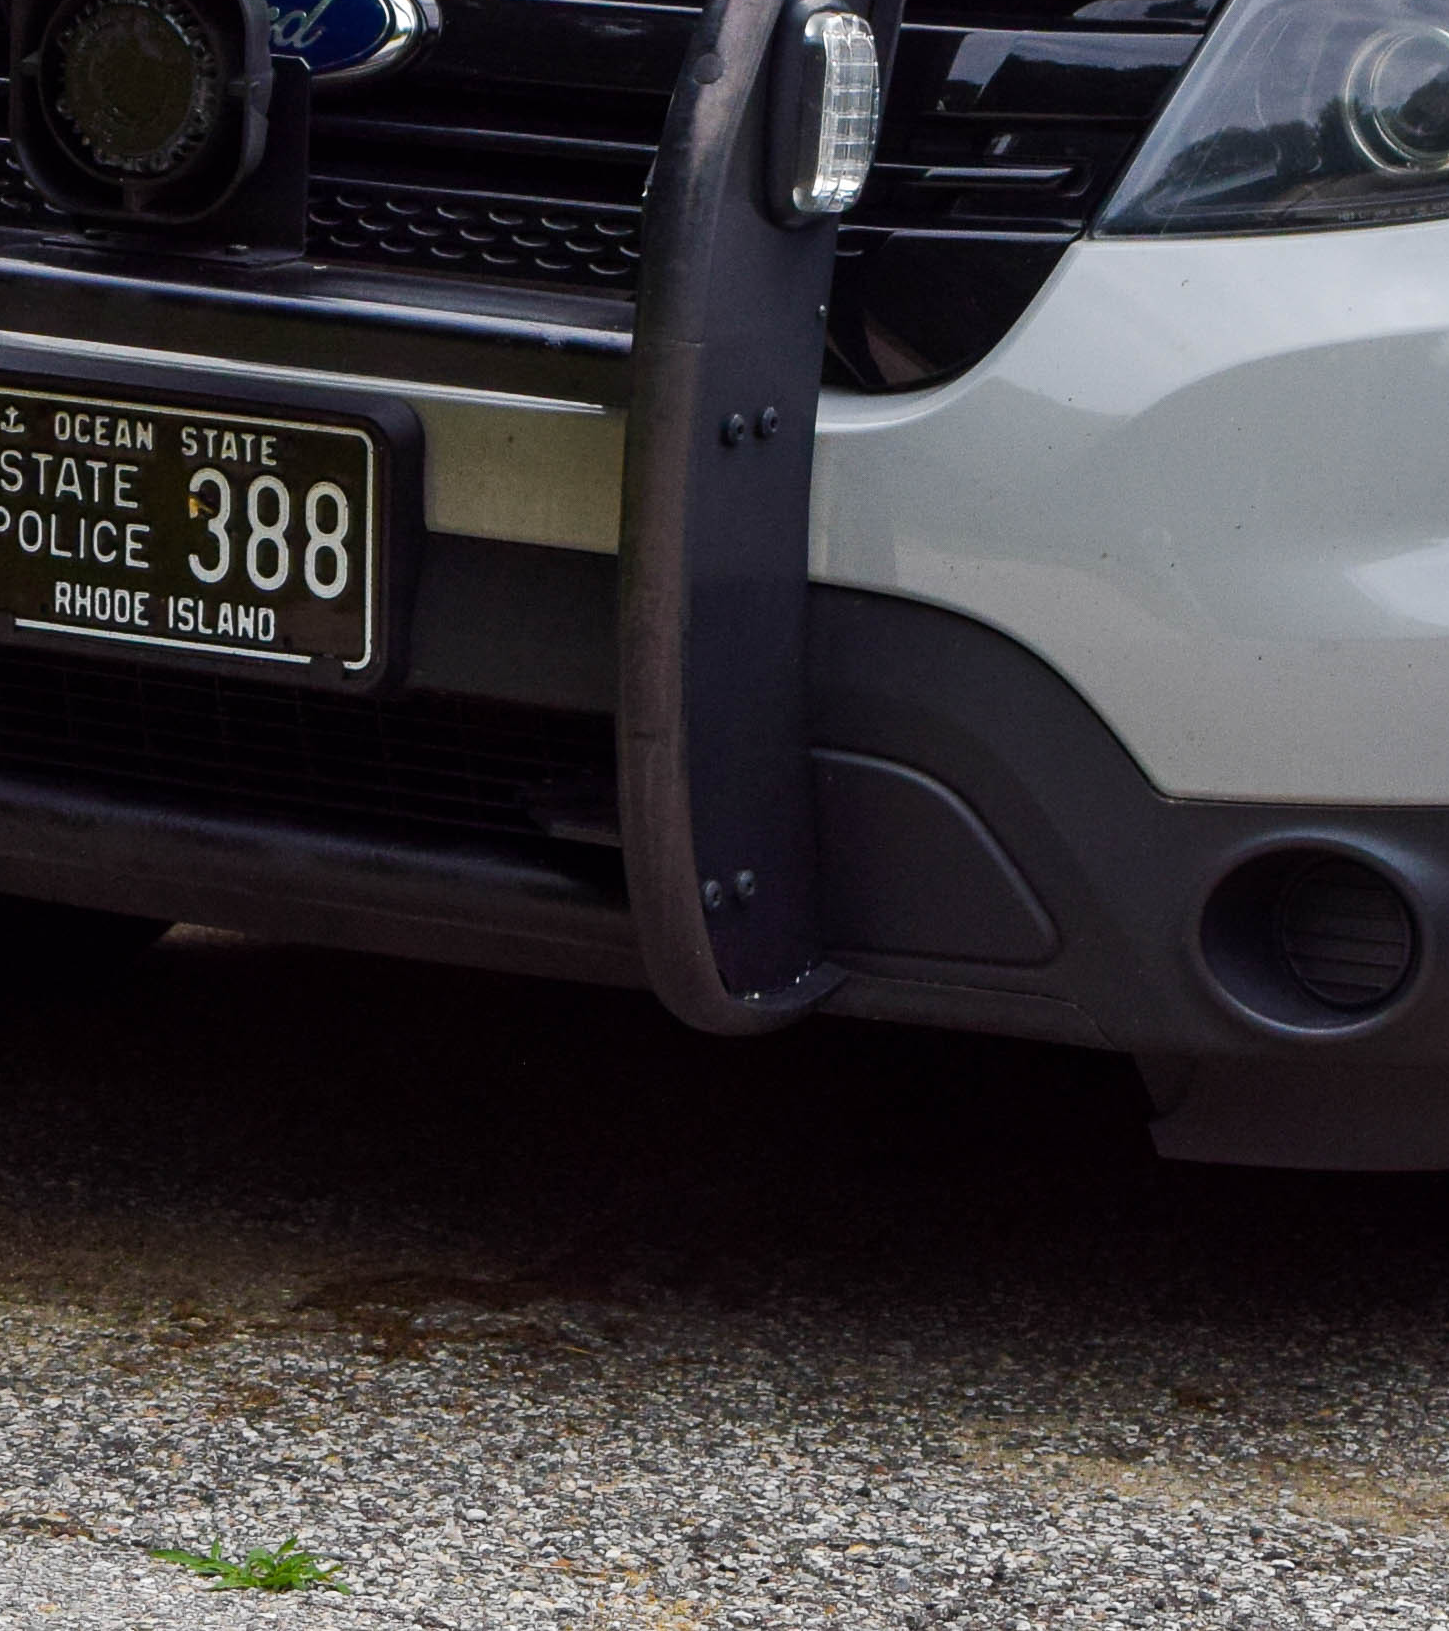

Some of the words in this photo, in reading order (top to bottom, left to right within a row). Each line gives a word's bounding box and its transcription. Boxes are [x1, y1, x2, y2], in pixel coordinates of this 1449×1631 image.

[54, 410, 154, 451] OCEAN
[180, 426, 278, 466] STATE
[0, 450, 140, 509] STATE
[188, 467, 349, 599] 388
[54, 581, 151, 627] RHODE
[167, 595, 276, 642] ISLAND
